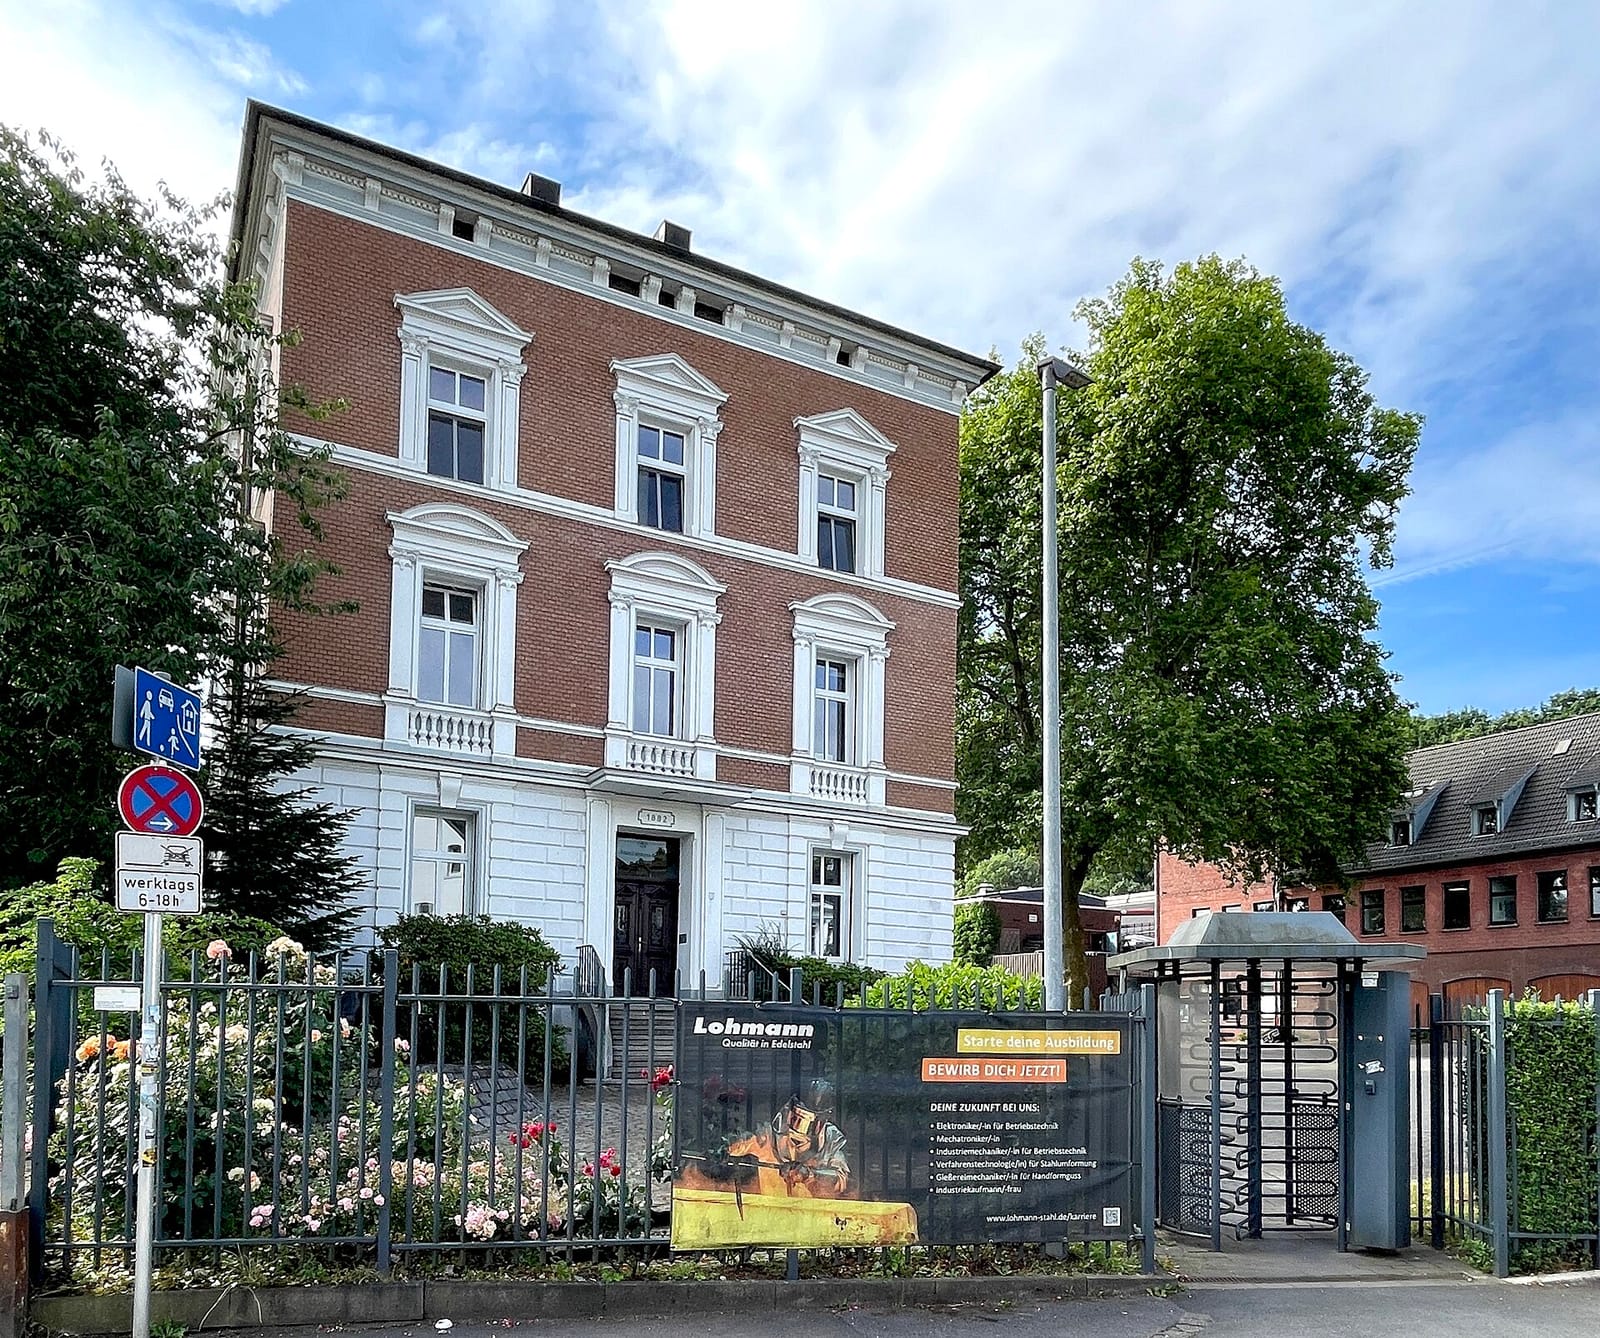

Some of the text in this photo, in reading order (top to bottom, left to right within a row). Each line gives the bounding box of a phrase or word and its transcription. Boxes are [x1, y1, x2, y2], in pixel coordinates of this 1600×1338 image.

[647, 813, 667, 823] 1882
[124, 877, 195, 893] werktags
[694, 1016, 814, 1037] Lohmann
[722, 1038, 811, 1049] Qualität in Edelstahl
[964, 1035, 1114, 1051] Starte deine Ausbildung
[928, 1063, 1061, 1077] BEWIRB DICH JETZT!
[930, 1104, 1040, 1112] DEINE ZUKUNFT BEI UNS:
[937, 1122, 1058, 1130] Elektroniker/-in für Betriebstechnik
[937, 1135, 1000, 1143] Mechatroniker/-in
[937, 1147, 1020, 1156] Industriemechaniker/-in
[1021, 1147, 1032, 1155] für
[1029, 1160, 1039, 1168] für
[1041, 1160, 1096, 1169] Stahlumformung
[1020, 1172, 1030, 1181] für
[1032, 1173, 1082, 1181] Handformguss
[986, 1212, 1097, 1223] www.lohmann-stahl.de/karriere
